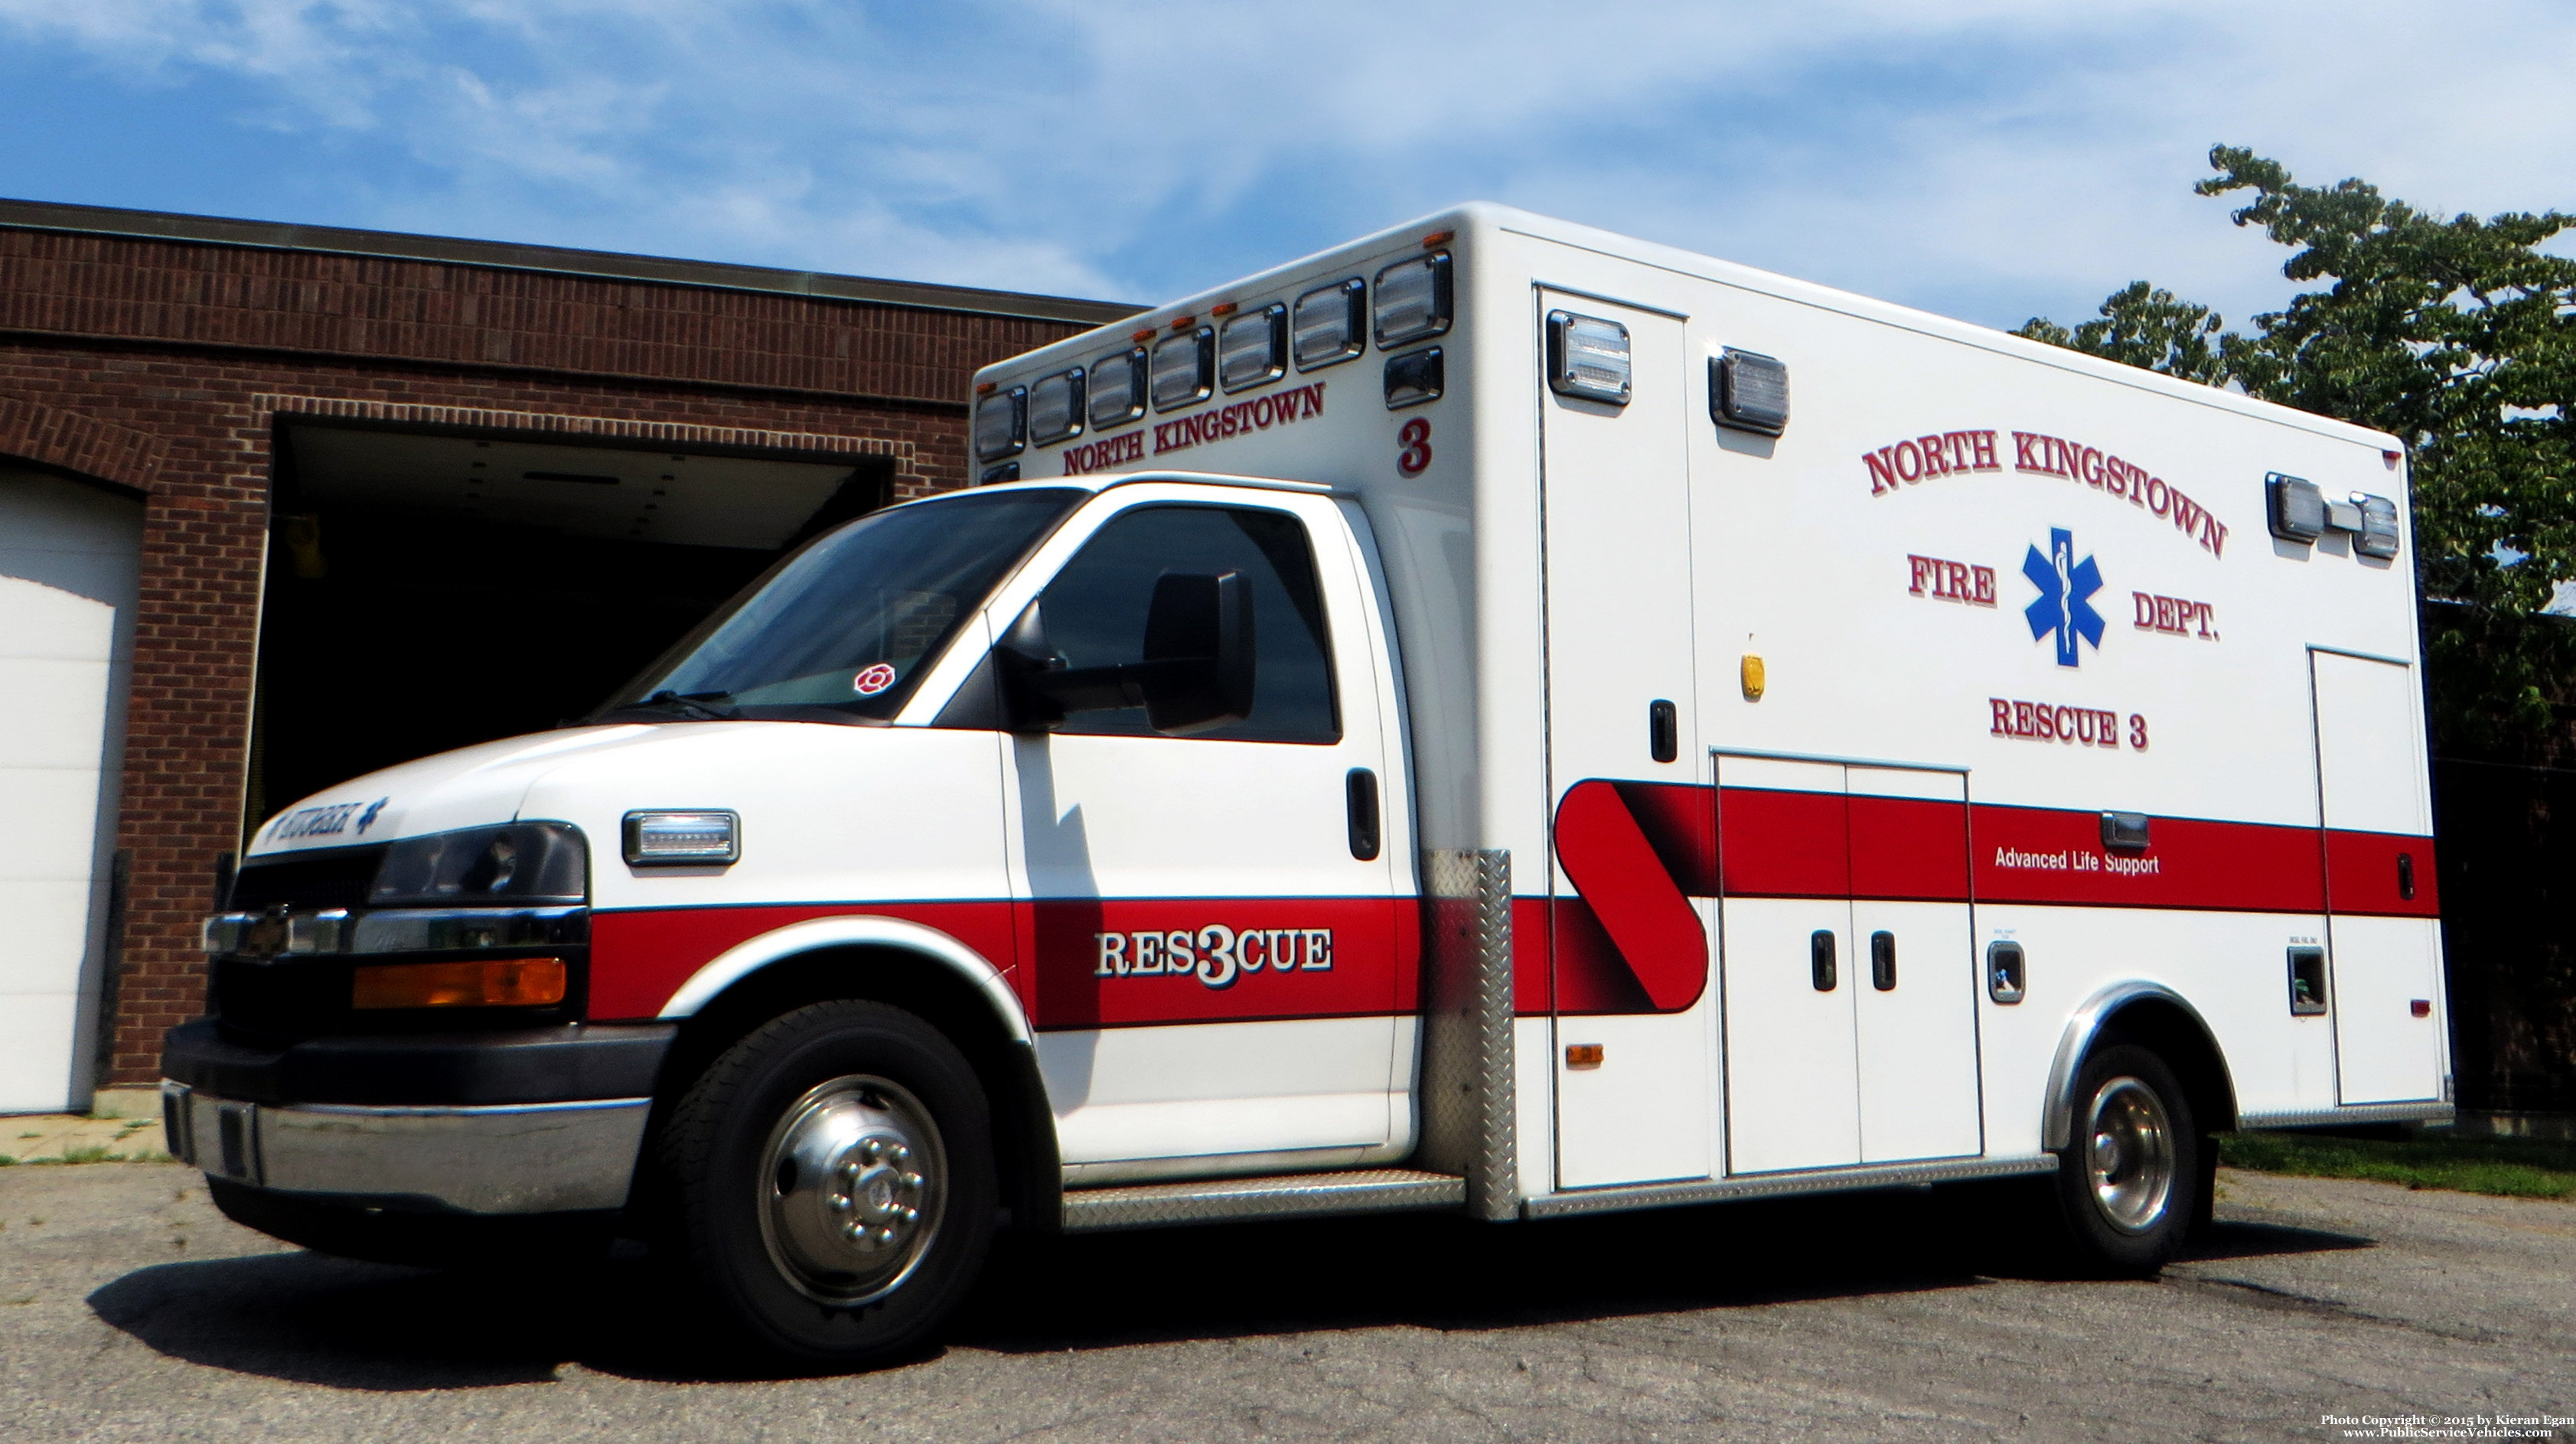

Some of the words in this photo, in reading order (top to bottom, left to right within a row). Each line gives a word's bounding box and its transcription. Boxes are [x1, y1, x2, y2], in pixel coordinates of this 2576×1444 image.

[1062, 429, 1145, 478] NORTH
[1153, 383, 1325, 455] KINGSTOWN
[1397, 417, 1433, 480] 3
[1861, 429, 2002, 497] NORTH
[2010, 430, 2229, 561] KINGSTOWN
[1907, 553, 1997, 608] FIRE
[2132, 591, 2221, 641] DEPT.
[1988, 697, 2119, 749] RESCUE
[2129, 713, 2150, 753] 3
[1995, 846, 2066, 869] Advanced
[2072, 850, 2099, 871] Life
[2105, 852, 2160, 876] Support
